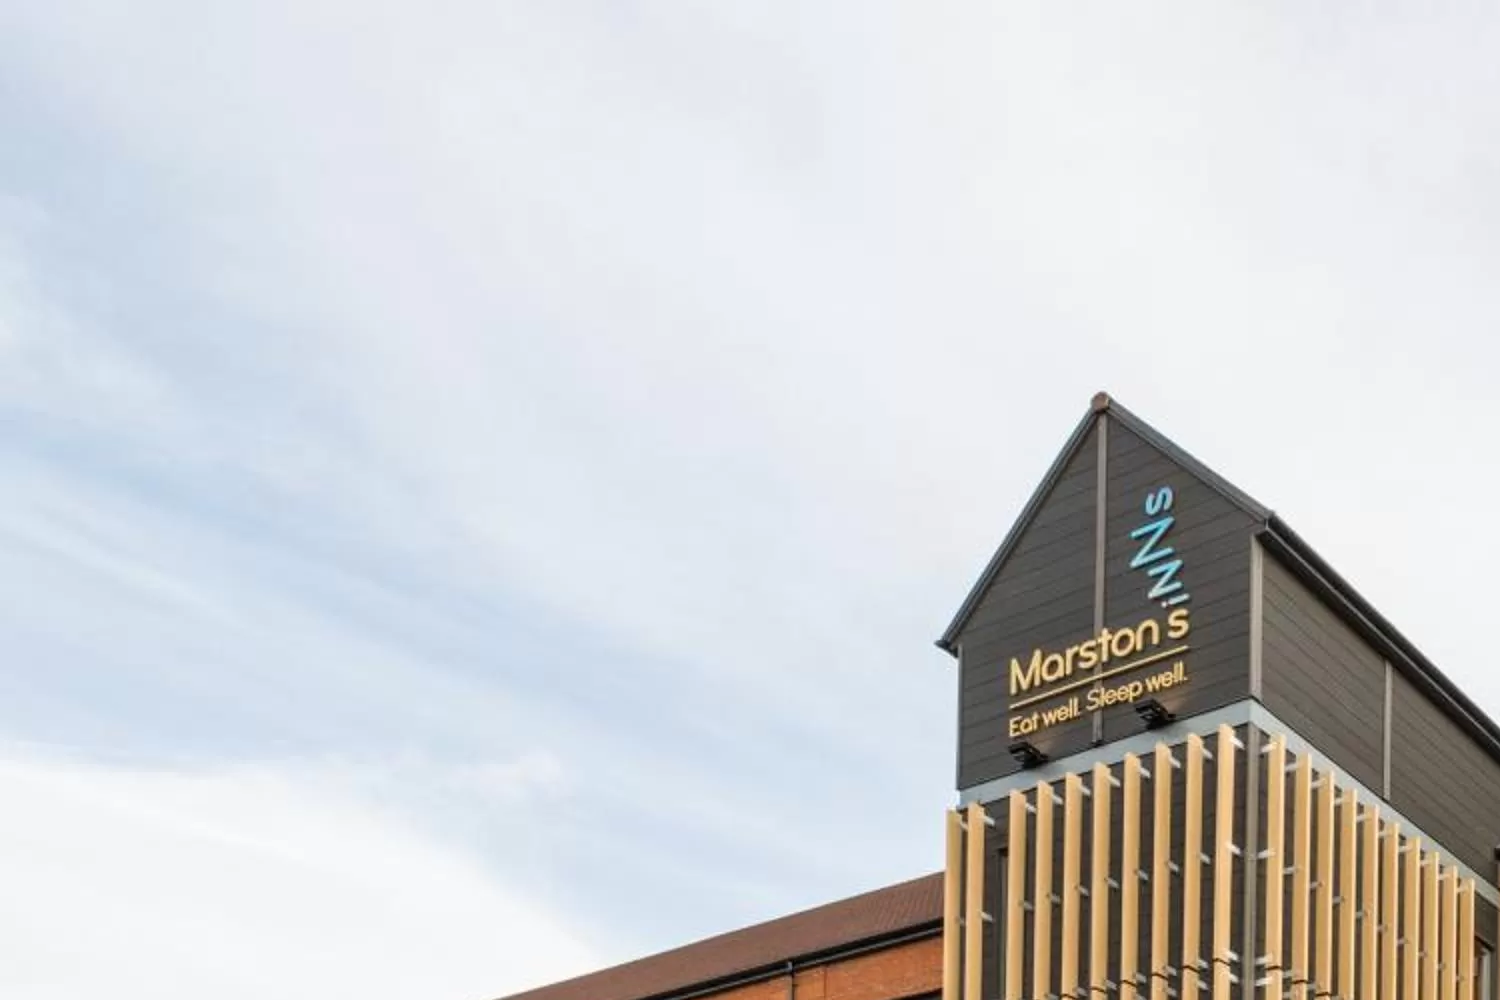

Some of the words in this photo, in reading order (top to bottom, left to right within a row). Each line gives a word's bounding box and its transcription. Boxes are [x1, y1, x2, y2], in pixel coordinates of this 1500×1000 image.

[1008, 712, 1039, 738] Eat
[1043, 697, 1081, 726] well.
[1086, 680, 1143, 712] Sleep
[1146, 660, 1188, 692] well.
